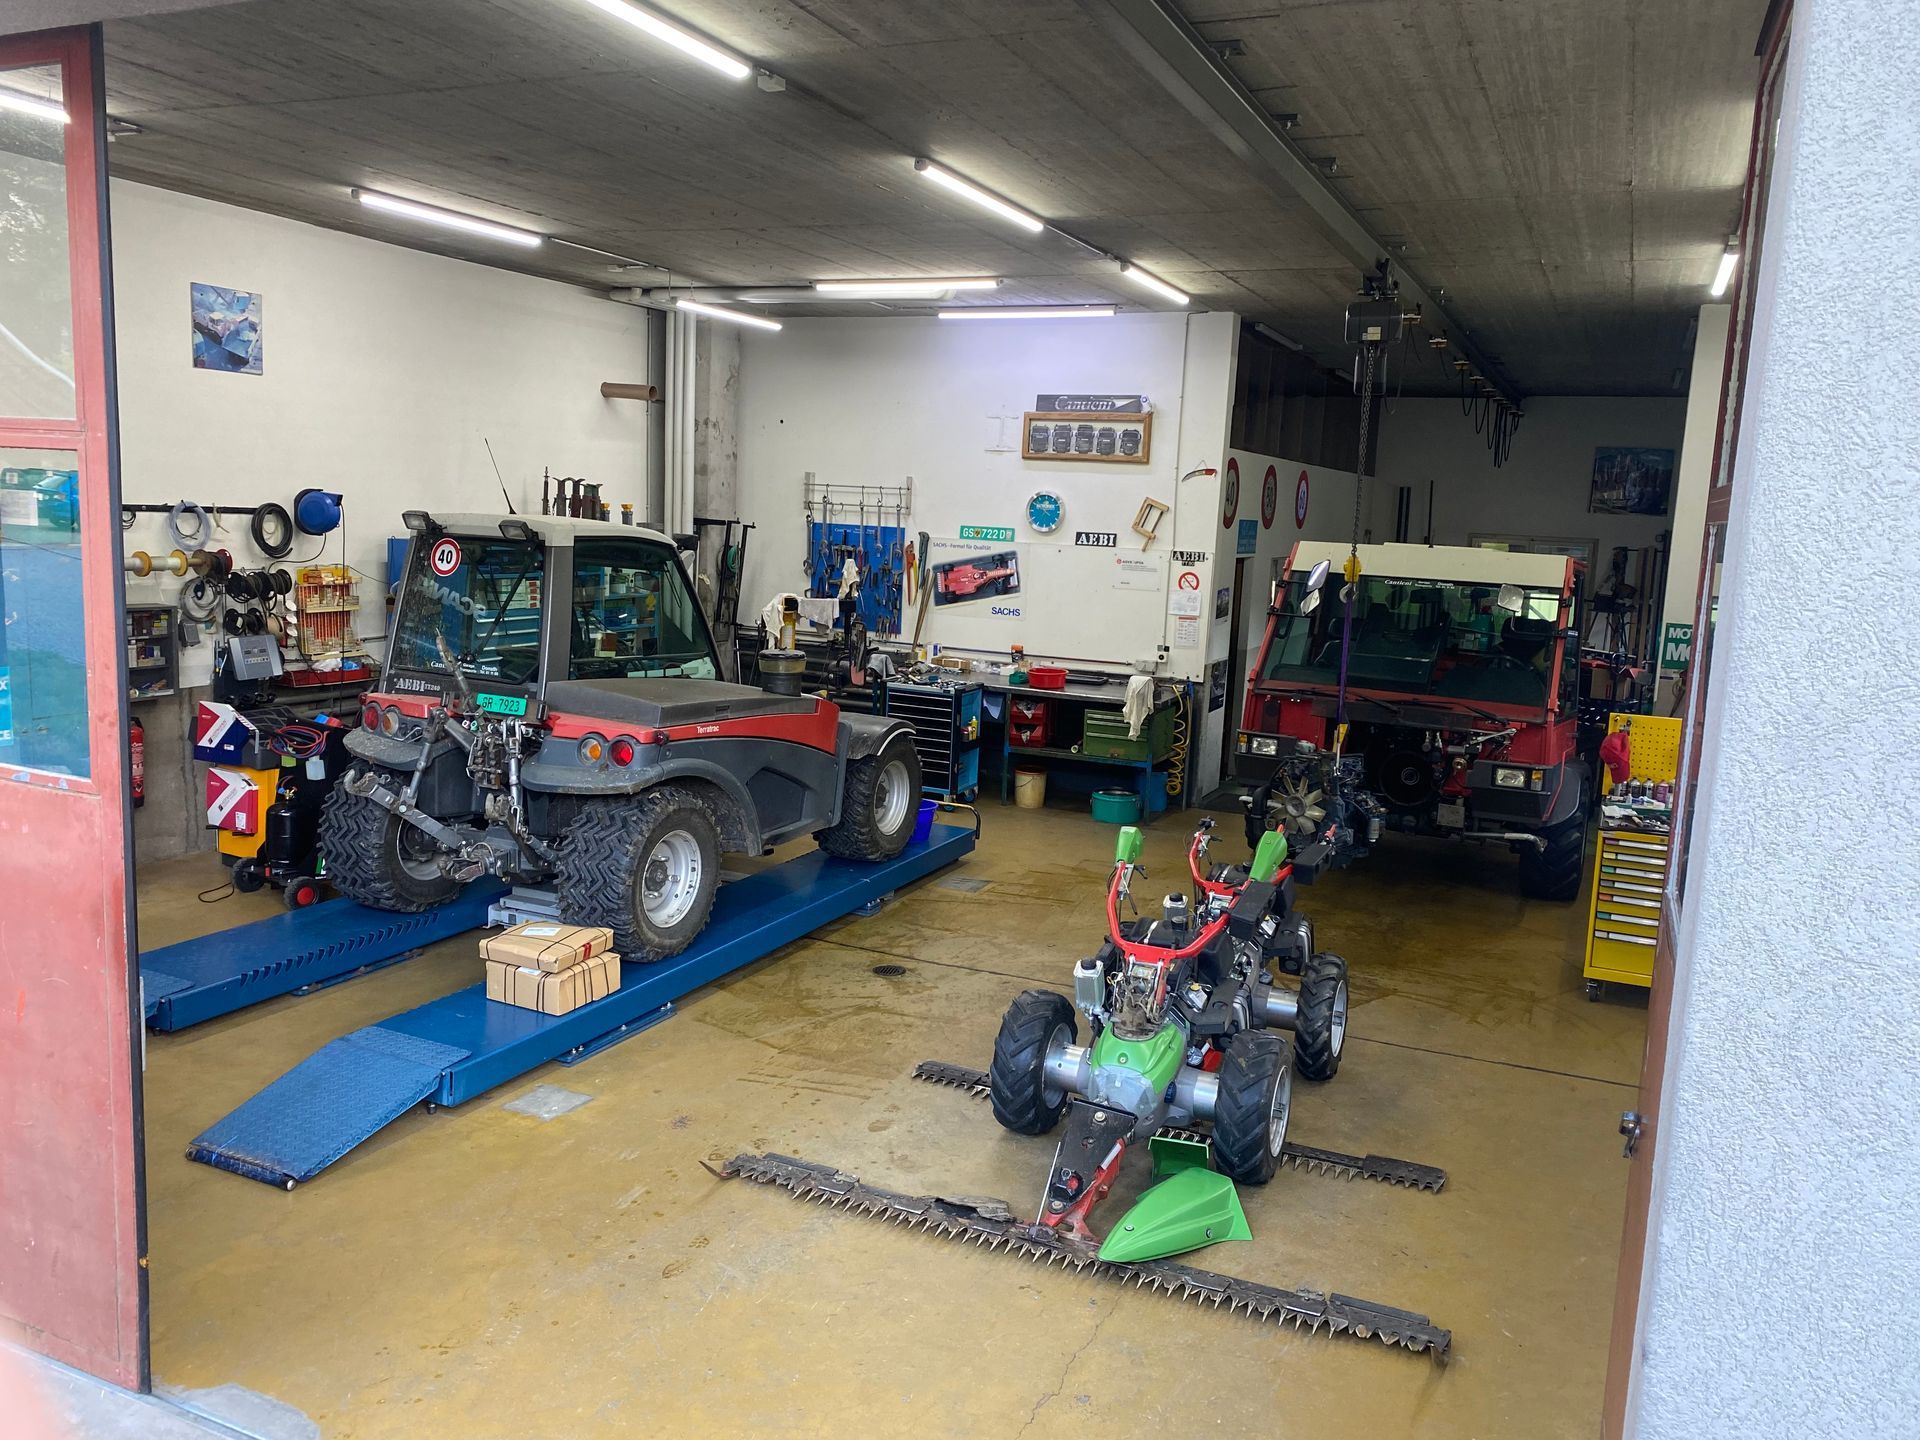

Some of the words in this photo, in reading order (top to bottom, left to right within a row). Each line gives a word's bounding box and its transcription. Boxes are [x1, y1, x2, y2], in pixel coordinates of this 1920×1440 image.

[963, 528, 974, 537] GS
[982, 528, 998, 539] 722
[1077, 533, 1115, 546] AEBI
[438, 549, 453, 564] 40
[1174, 551, 1204, 562] AEBI
[992, 606, 1021, 617] SACHS
[395, 677, 426, 692] AEBI
[482, 696, 493, 708] GR
[500, 698, 520, 713] 7923
[697, 725, 720, 734] Terratrac
